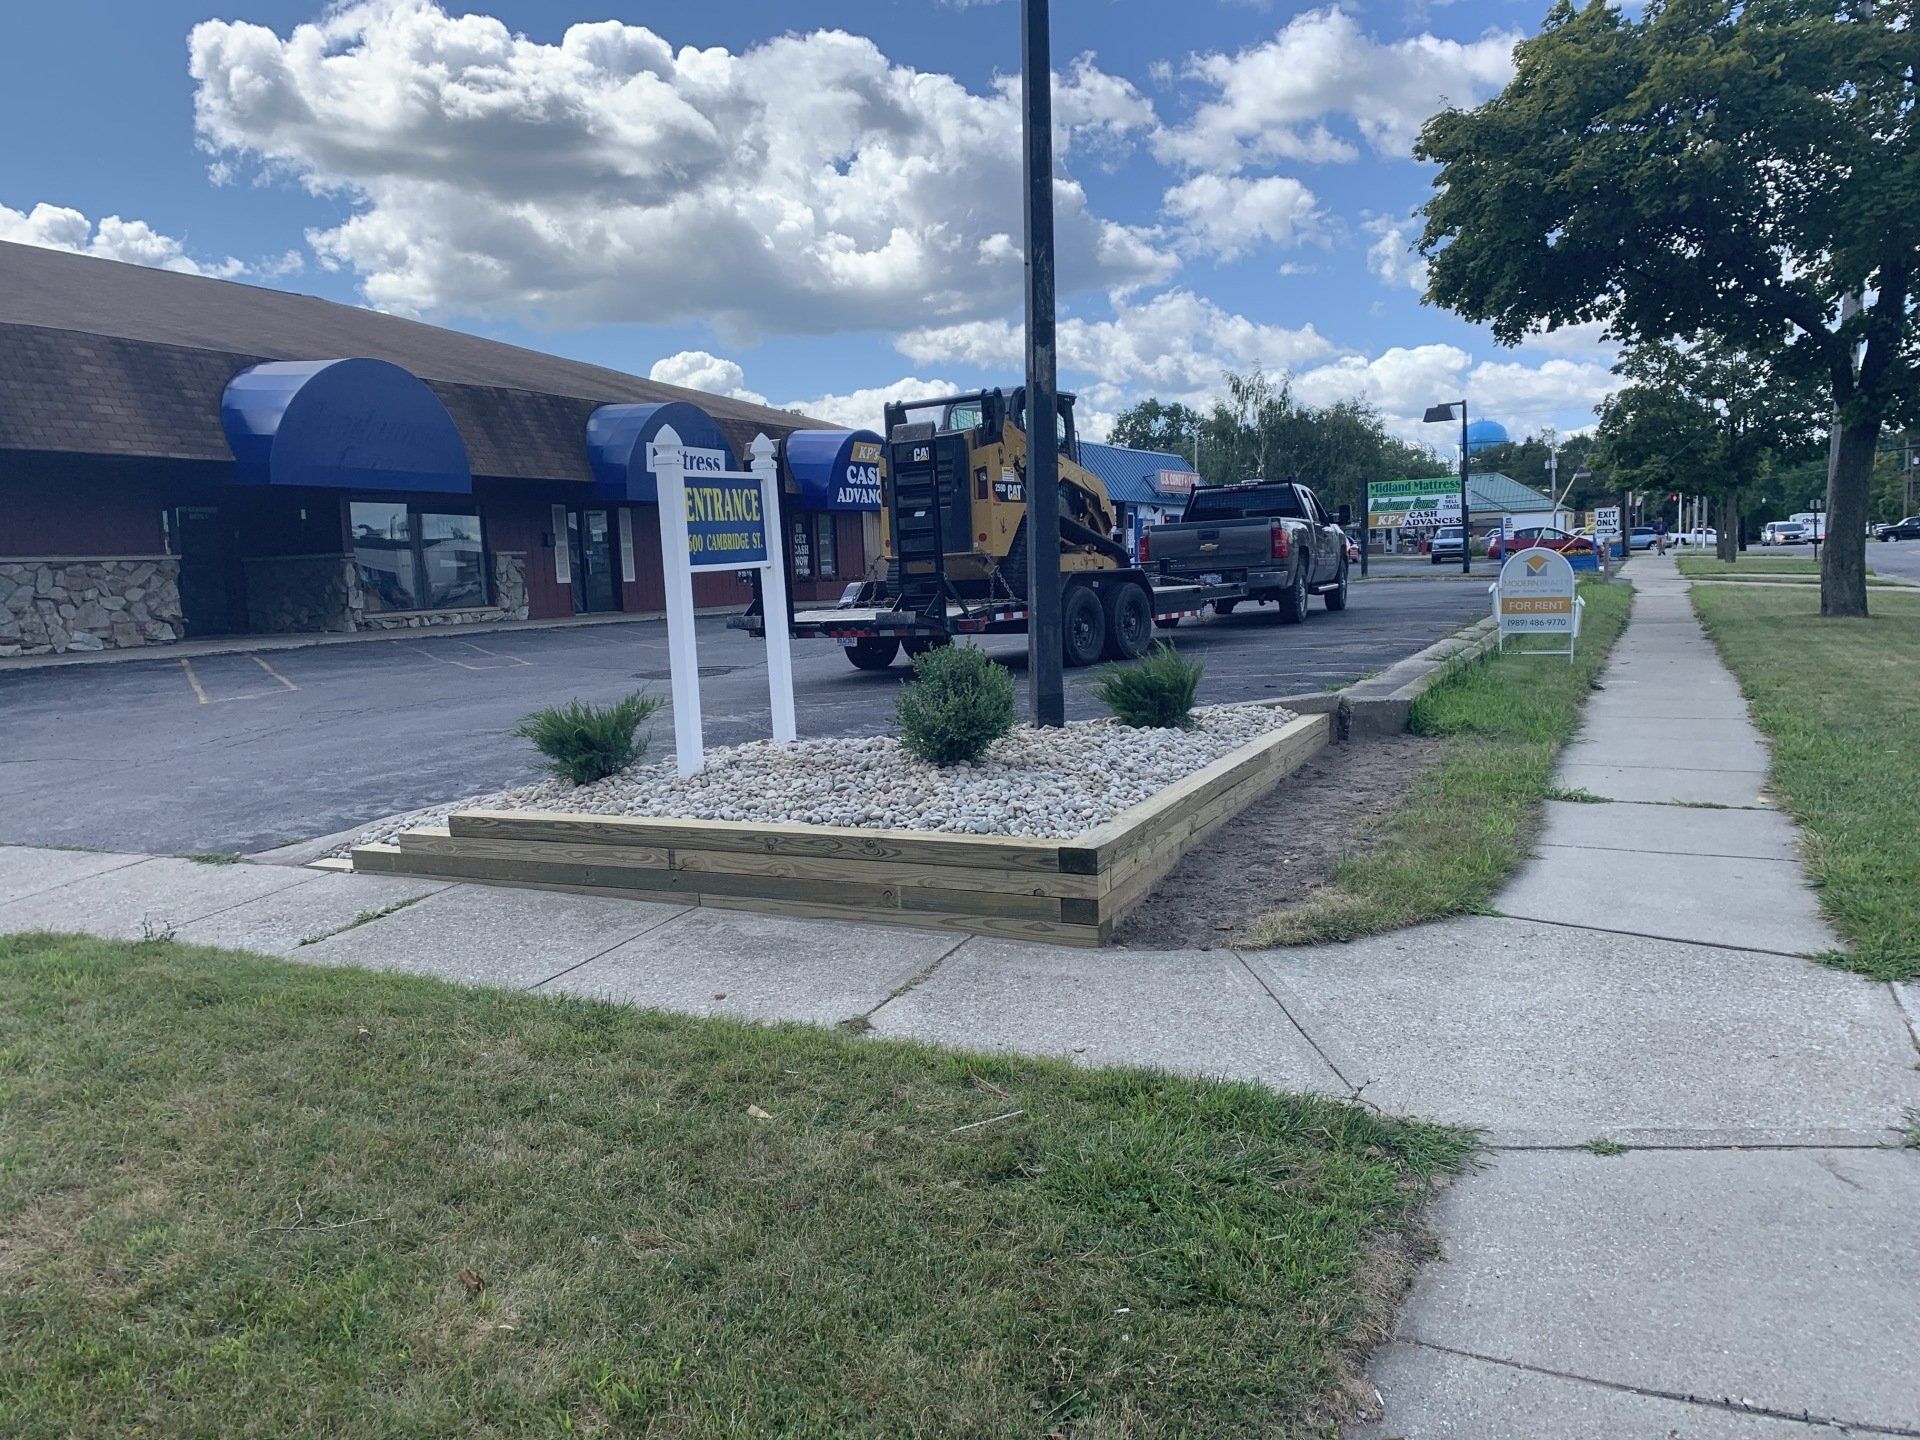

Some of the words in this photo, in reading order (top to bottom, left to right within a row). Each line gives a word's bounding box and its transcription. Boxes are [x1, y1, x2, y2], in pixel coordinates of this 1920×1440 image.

[1370, 481, 1411, 493] Midland
[1413, 479, 1461, 491] Mattress
[1007, 484, 1022, 500] CAT
[685, 487, 760, 522] ENTRANCE
[1377, 515, 1404, 525] KP's
[1405, 517, 1462, 526] ADVANCES
[706, 532, 750, 551] CAMBRIDGE
[752, 531, 763, 549] ST.
[794, 534, 807, 544] GET
[1509, 601, 1532, 611] FOR
[1535, 601, 1564, 610] RENT
[1507, 619, 1528, 627] (989)
[1529, 618, 1567, 627] 486-9770
